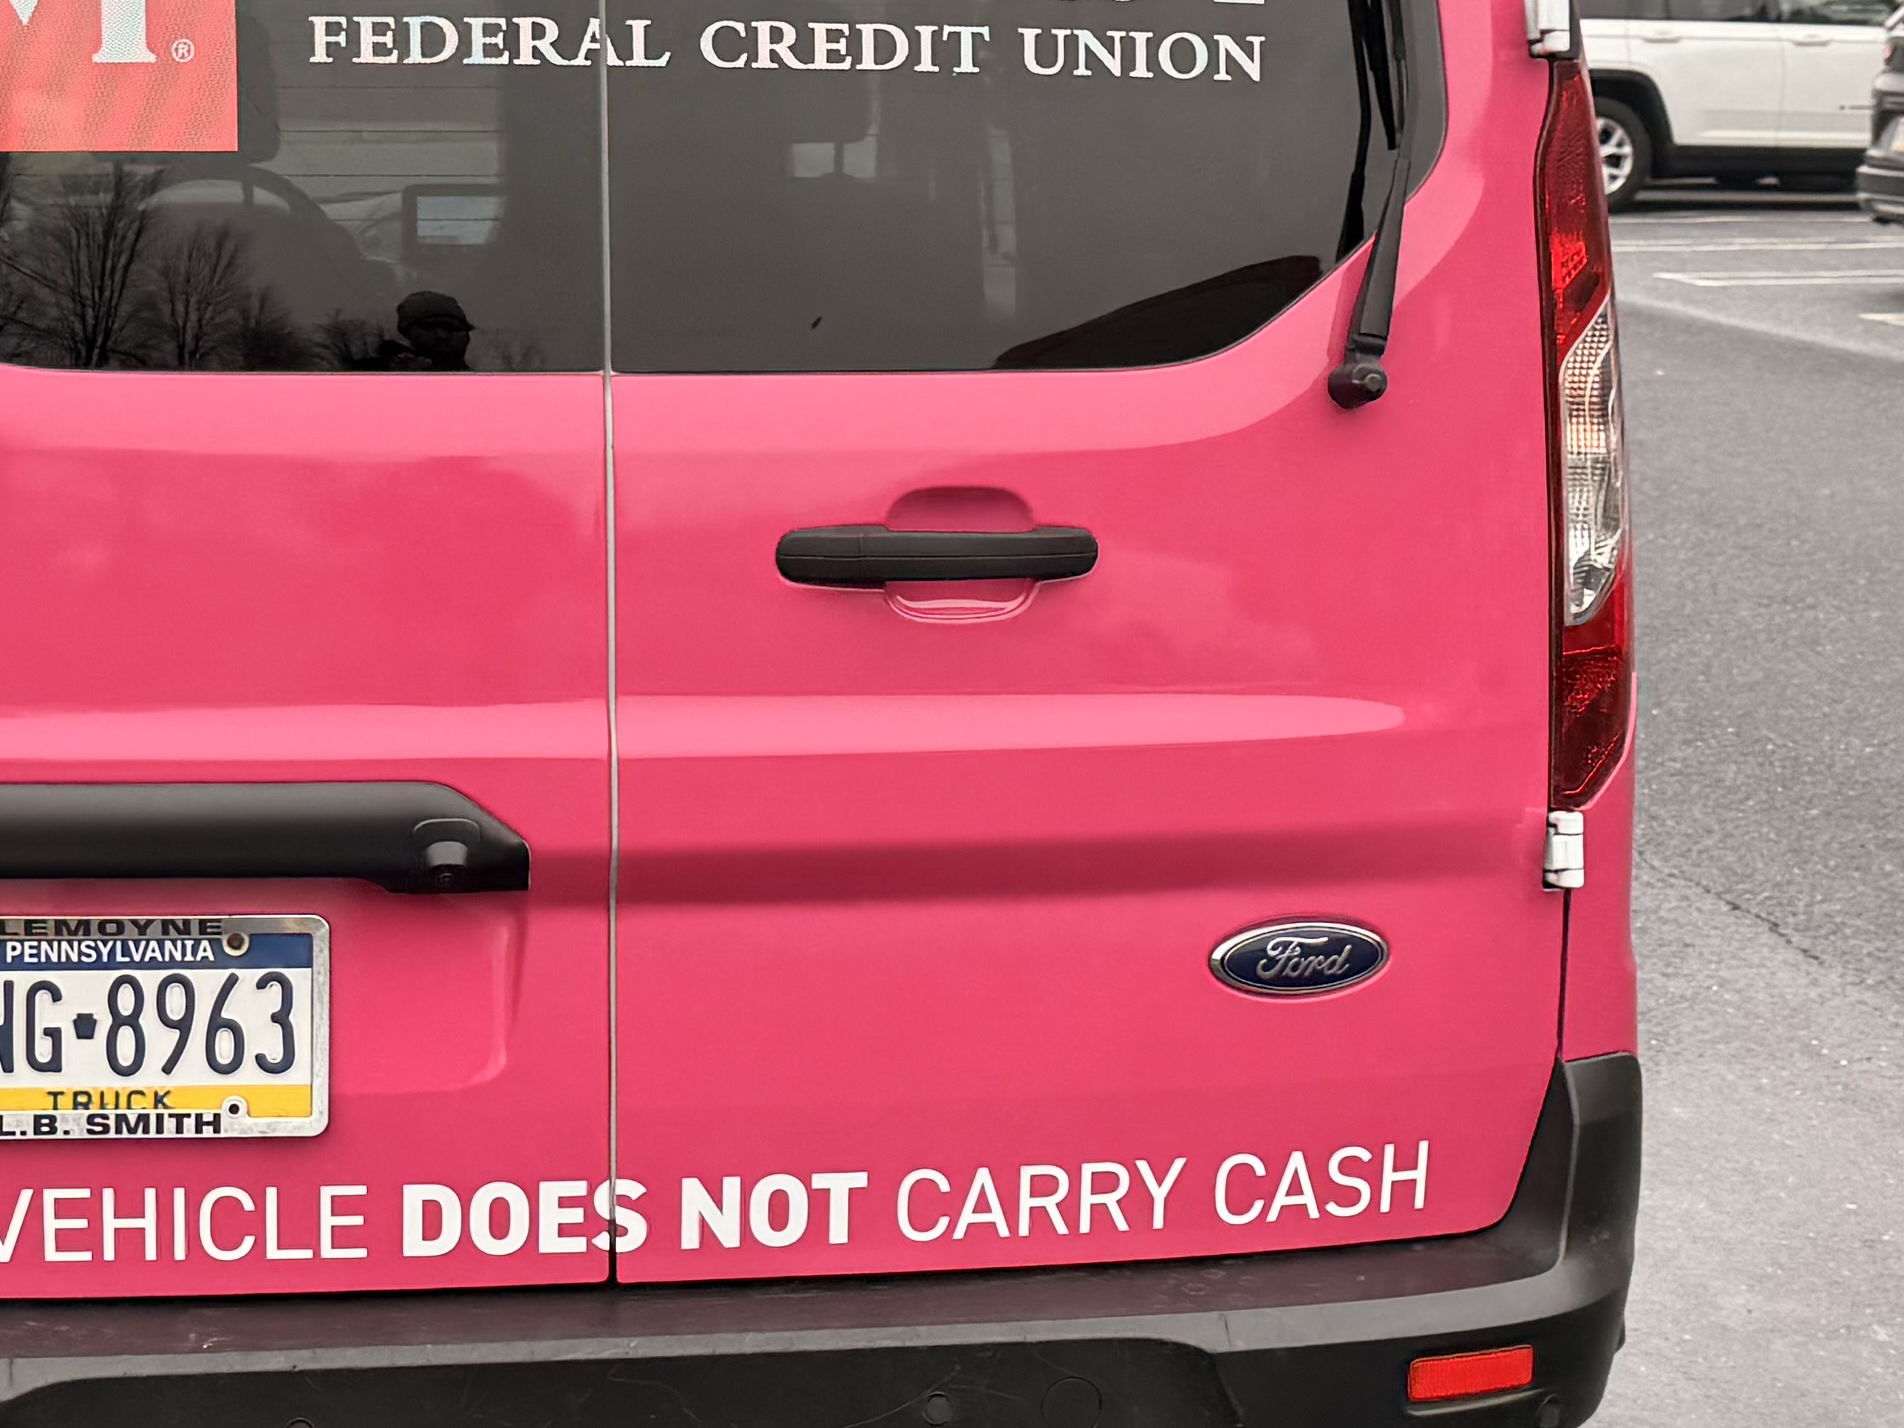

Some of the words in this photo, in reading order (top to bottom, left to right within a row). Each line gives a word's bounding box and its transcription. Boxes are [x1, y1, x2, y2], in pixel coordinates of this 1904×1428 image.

[308, 15, 671, 67] FEDERAL
[699, 19, 990, 74] CREDIT
[1017, 27, 1266, 82] UNION
[5, 939, 215, 964] PENNSYLVANIA
[1256, 936, 1352, 979] Ford
[47, 1090, 173, 1111] TRUCK
[86, 1112, 222, 1135] SMITH
[402, 1179, 648, 1257] DOES
[680, 1171, 869, 1251] NOT
[896, 1156, 1188, 1242] CARRY
[1213, 1140, 1431, 1224] CASH
